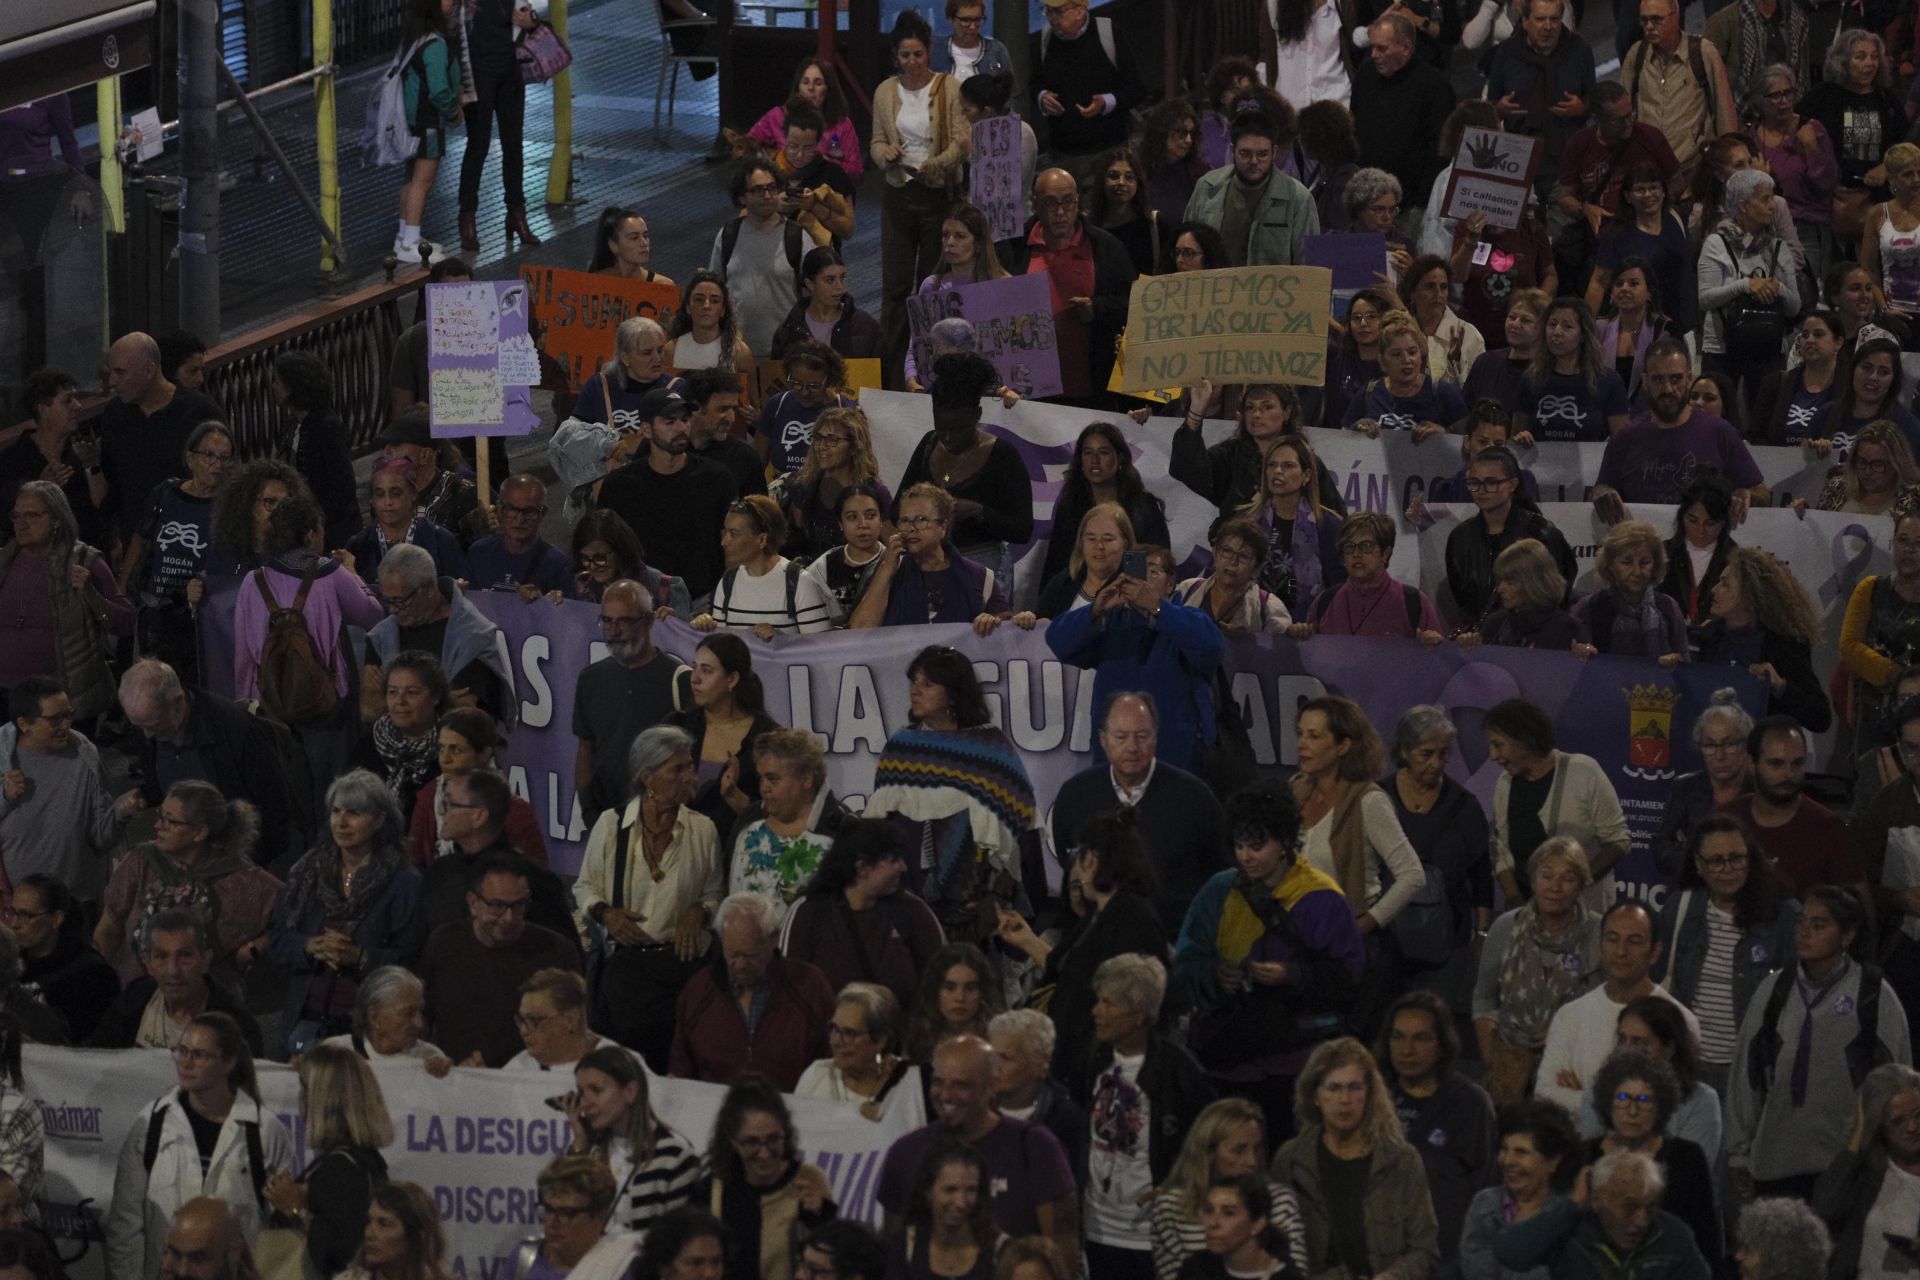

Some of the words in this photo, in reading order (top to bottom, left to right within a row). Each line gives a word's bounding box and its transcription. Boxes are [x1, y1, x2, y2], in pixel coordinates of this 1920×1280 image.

[1459, 200, 1479, 209] nos
[1481, 205, 1513, 217] matan
[1460, 187, 1471, 196] Si
[1473, 190, 1518, 206] callamos
[524, 269, 553, 304] NI
[1141, 272, 1300, 313] GRITEMOS
[1143, 311, 1185, 341] POR
[1191, 308, 1225, 336] LAS
[1228, 311, 1279, 334] QUE
[1281, 310, 1315, 334] YA
[1142, 352, 1188, 383] NO
[162, 555, 193, 567] MOGÁN
[787, 664, 889, 754] LA
[407, 1114, 447, 1153] LA
